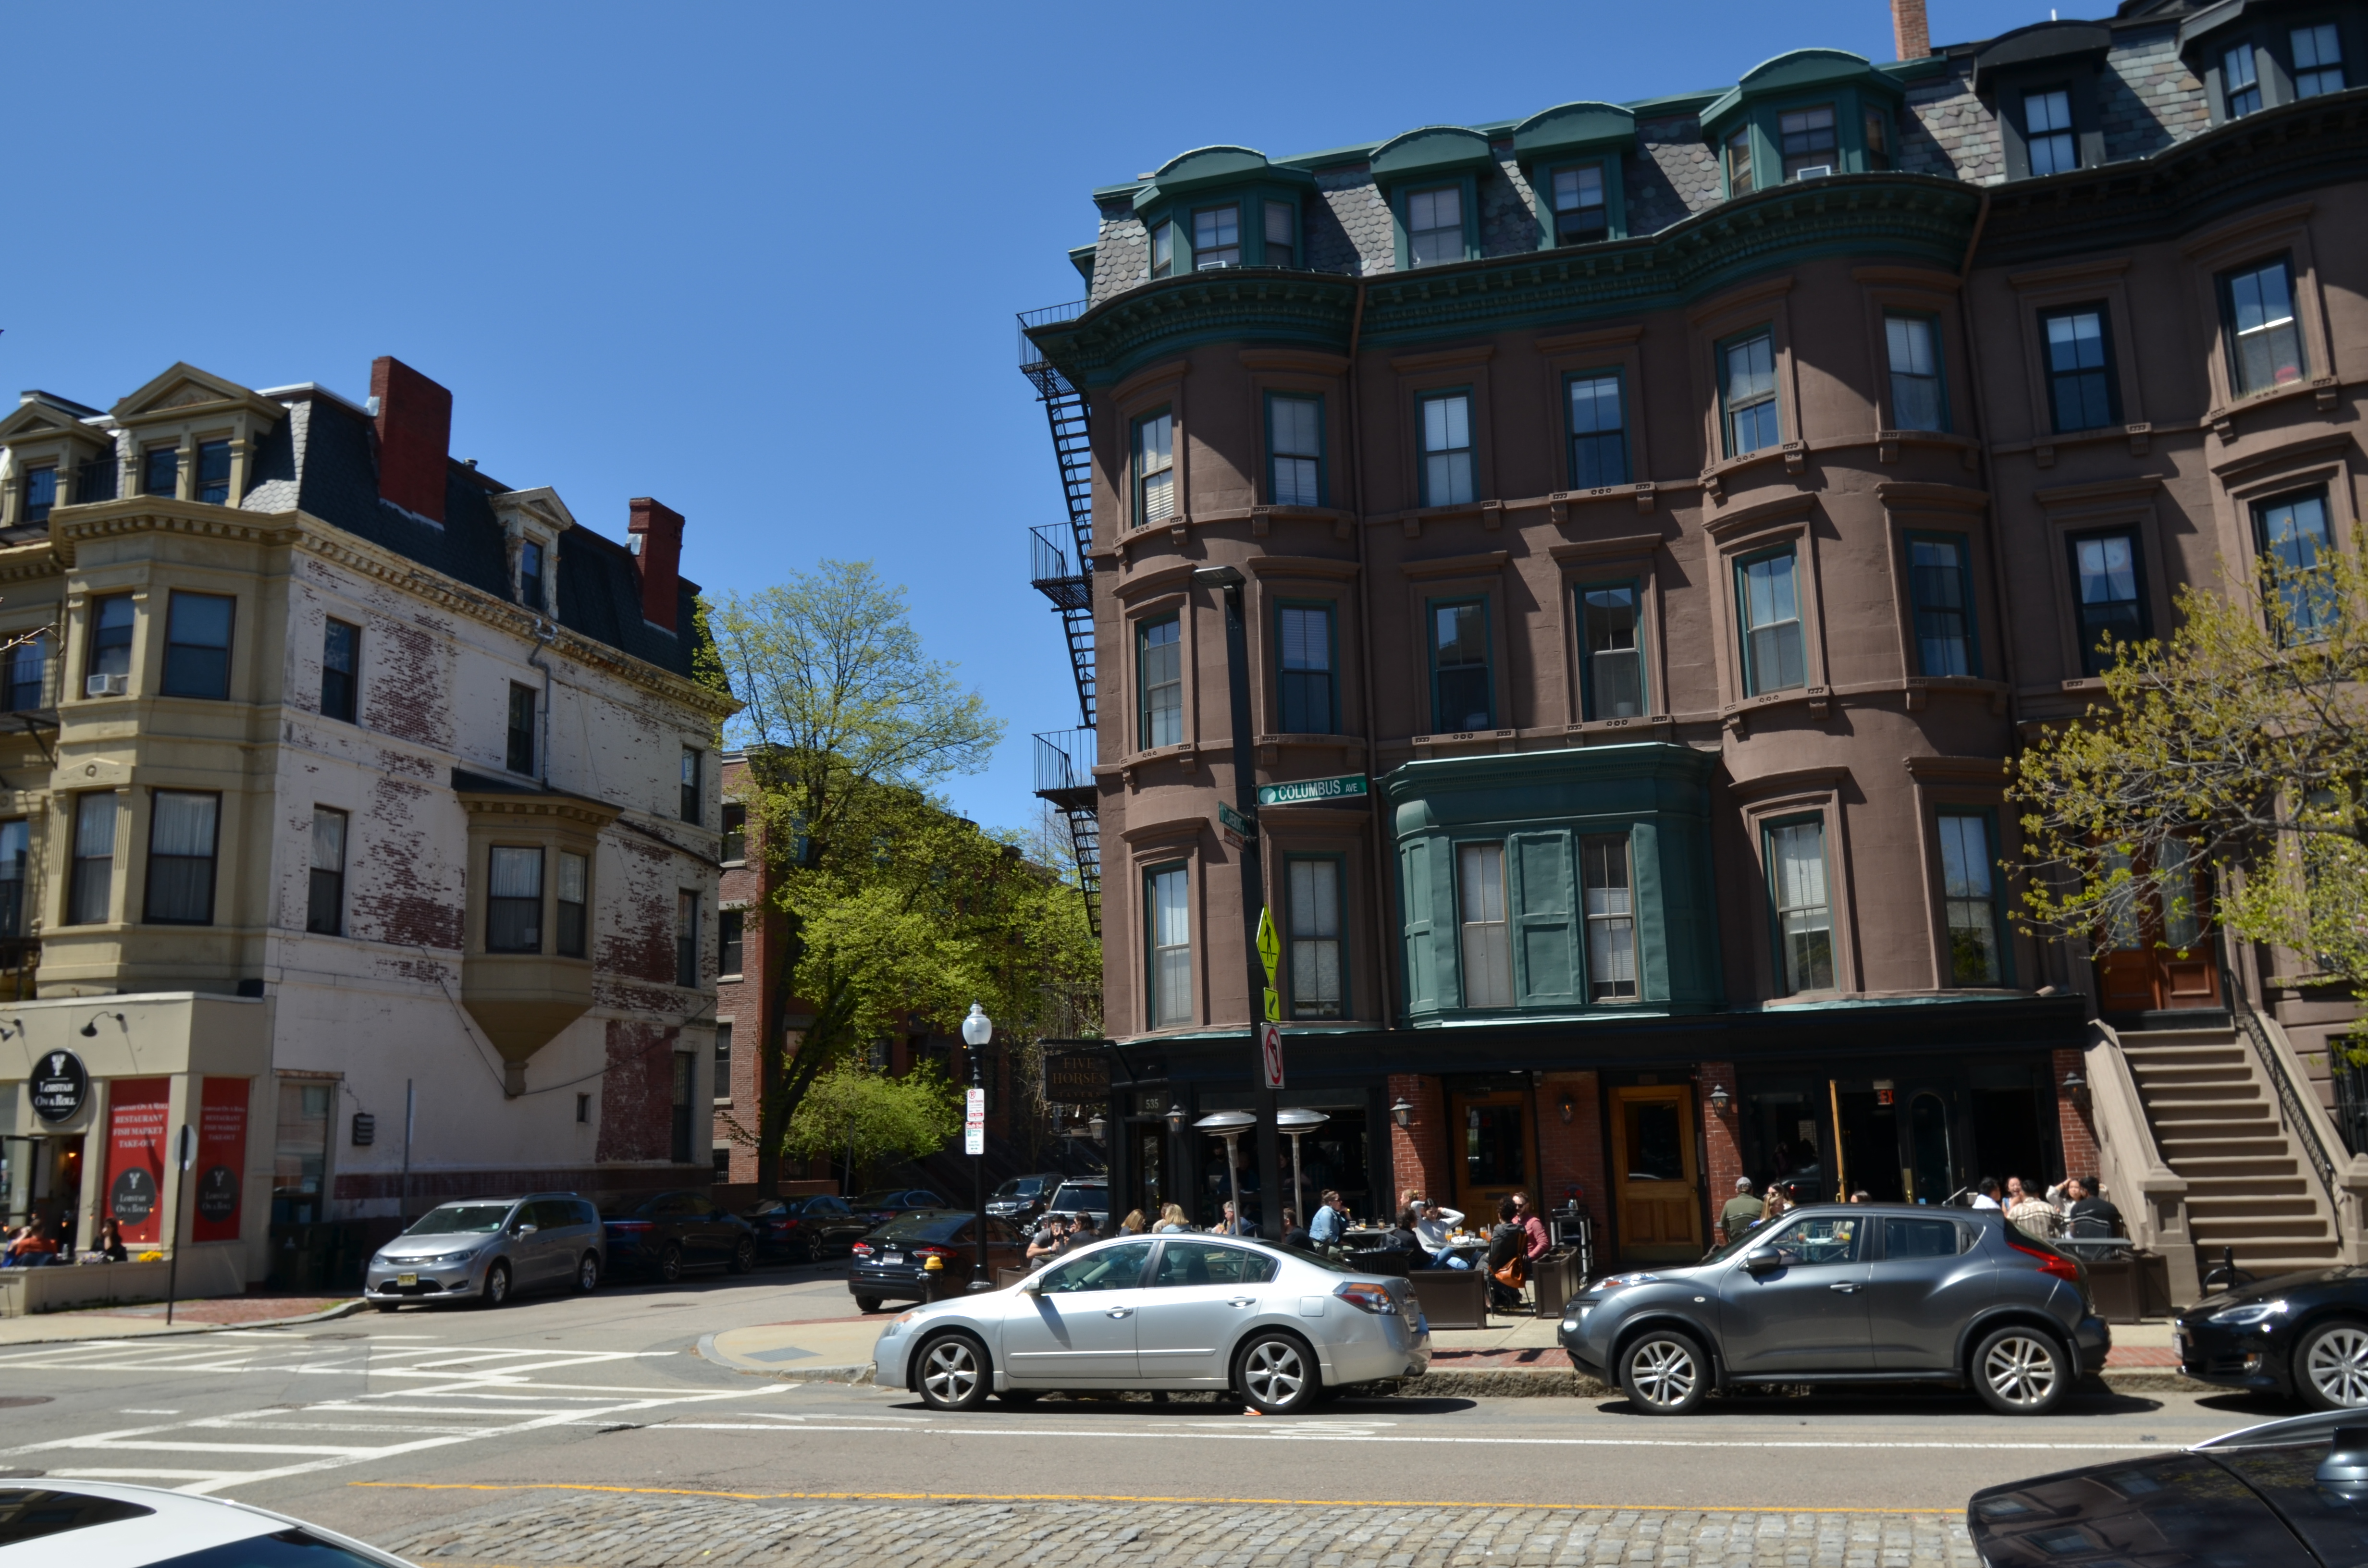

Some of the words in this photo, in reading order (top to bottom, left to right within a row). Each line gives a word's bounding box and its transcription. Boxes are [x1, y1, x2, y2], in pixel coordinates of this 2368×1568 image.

[1278, 780, 1341, 801] COLUMBUS
[1345, 783, 1357, 793] AVE
[1224, 808, 1242, 833] CLAREMONT
[1063, 1058, 1095, 1068] FIVE
[1052, 1072, 1107, 1085] HORSES
[1146, 1099, 1159, 1109] 535
[115, 1114, 163, 1123] RESTAURANT
[113, 1127, 130, 1136] FISH
[131, 1127, 163, 1135] MARKET
[119, 1139, 157, 1149] TAKE-OUT
